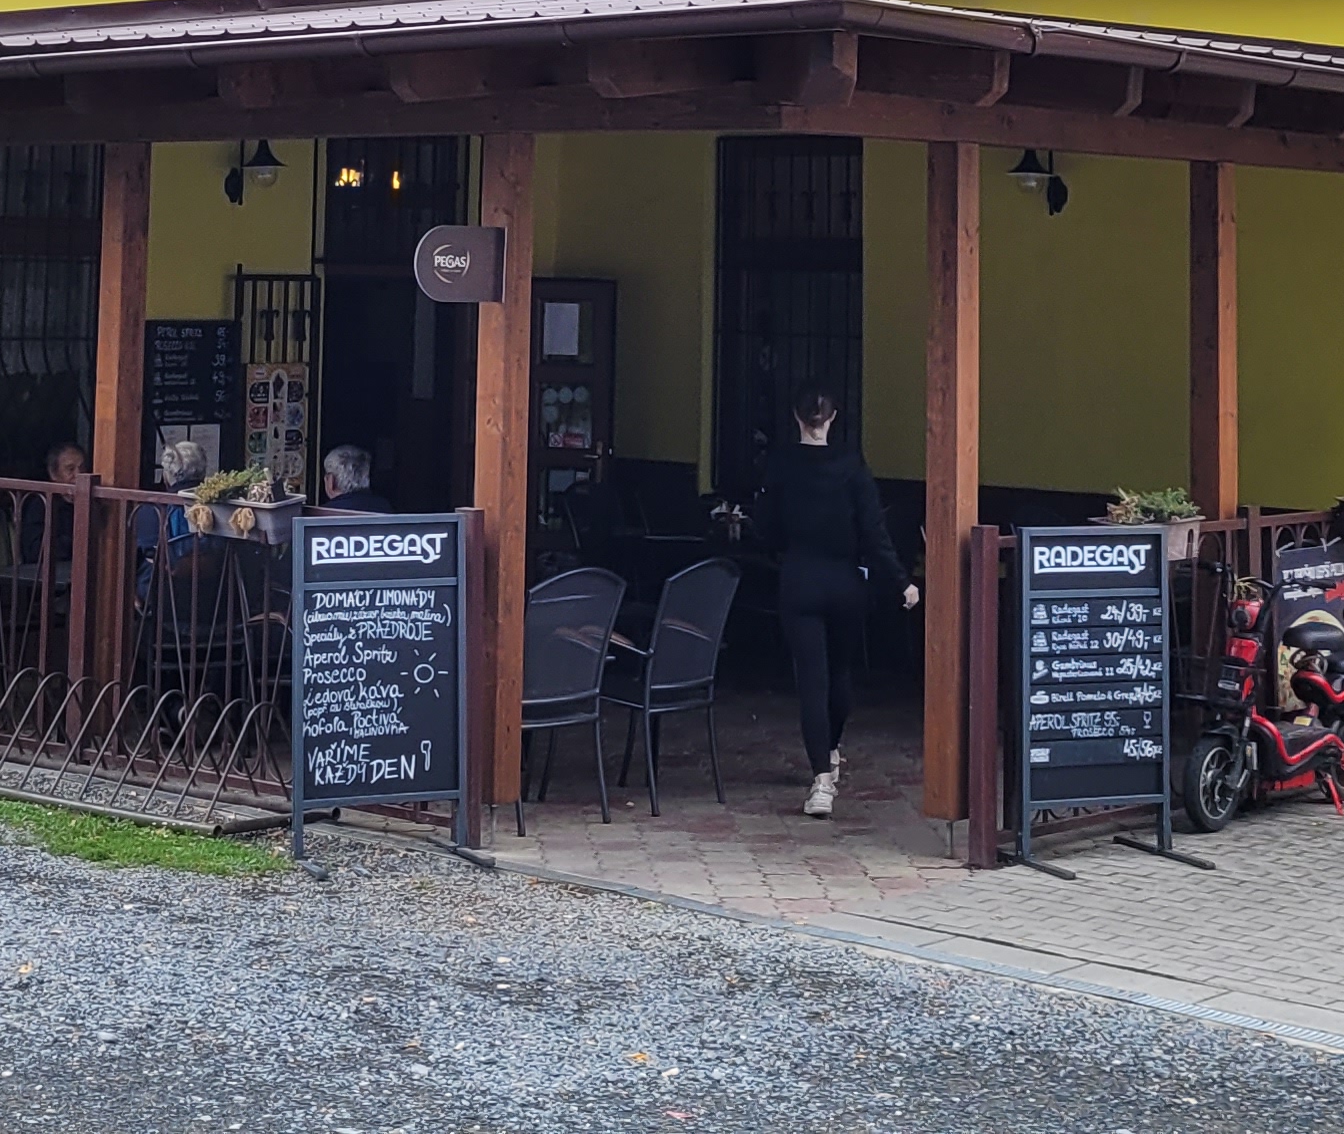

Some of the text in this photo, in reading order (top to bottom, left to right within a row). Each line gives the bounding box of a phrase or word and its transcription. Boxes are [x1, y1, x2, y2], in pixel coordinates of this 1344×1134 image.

[434, 254, 467, 268] PEGAS
[312, 532, 448, 565] RADEGAST
[1034, 544, 1152, 574] RADEGAST
[312, 589, 375, 610] DOMÁCÍ
[303, 646, 349, 669] Aperol
[302, 667, 367, 684] Prosecco
[357, 680, 404, 700] káva
[1029, 712, 1070, 731] APEROL
[308, 739, 372, 772] VAŘÍME
[370, 753, 416, 784] DEN
